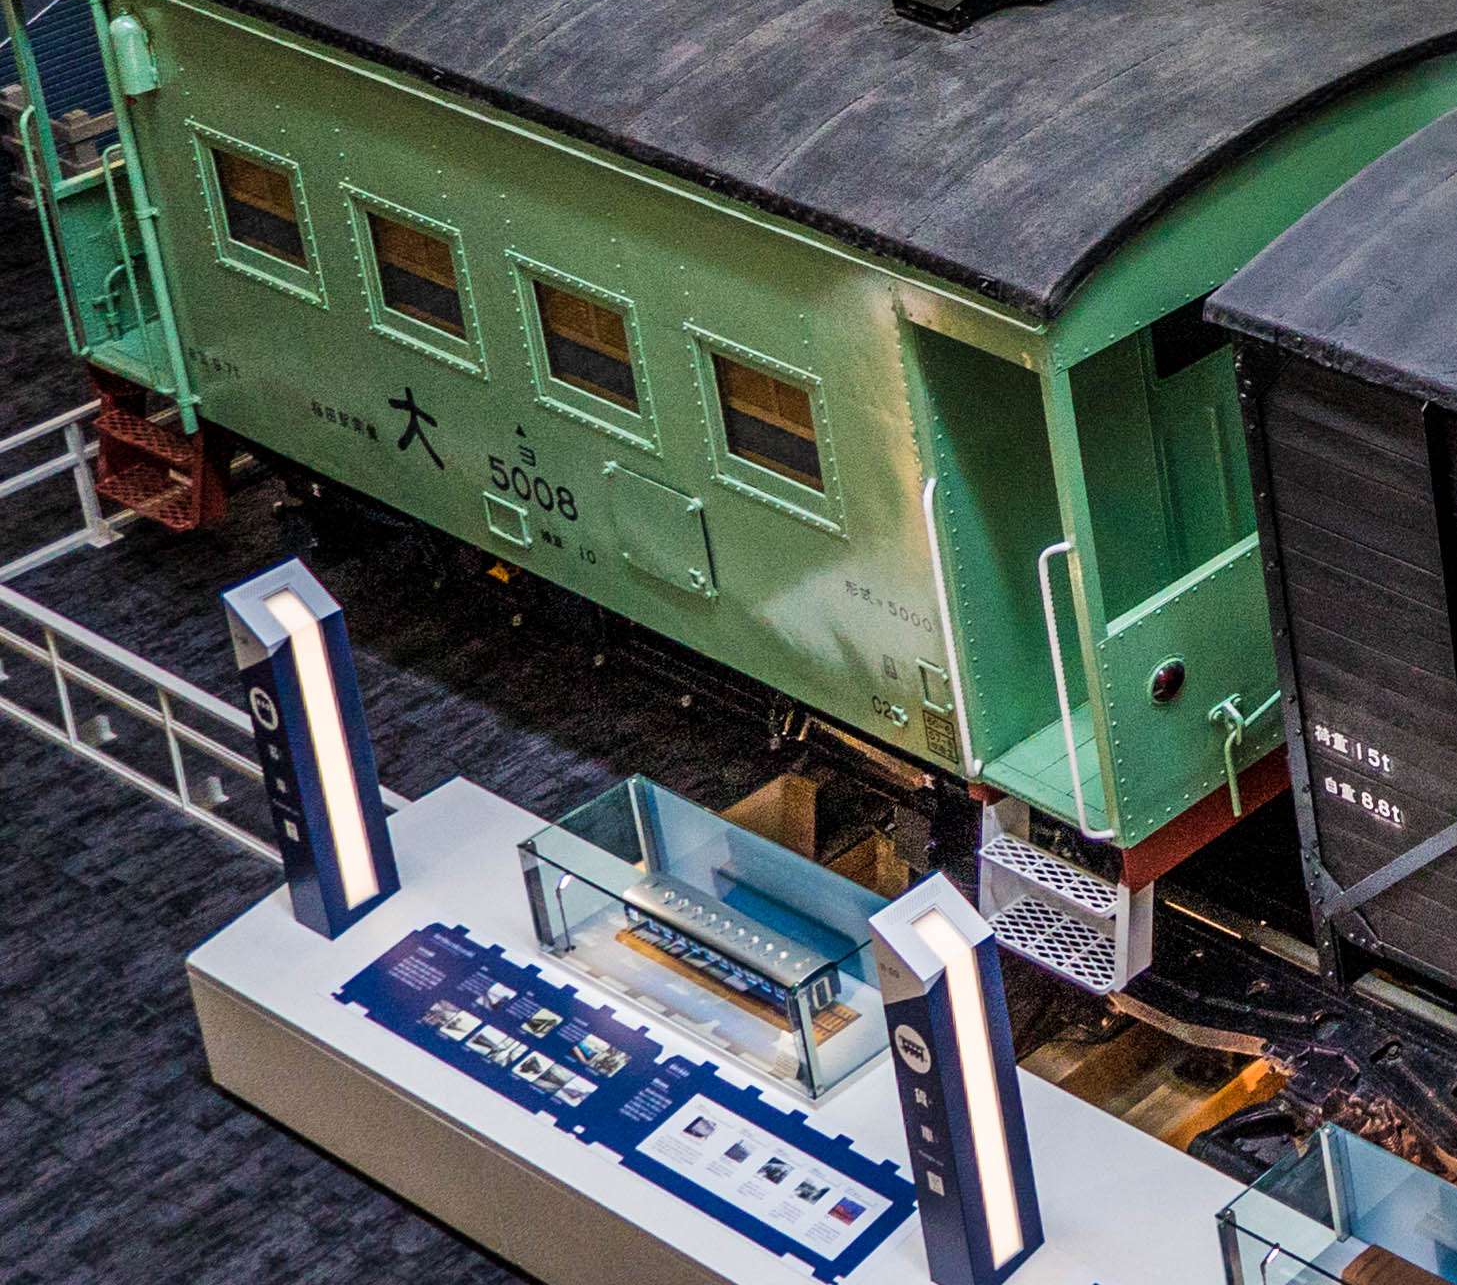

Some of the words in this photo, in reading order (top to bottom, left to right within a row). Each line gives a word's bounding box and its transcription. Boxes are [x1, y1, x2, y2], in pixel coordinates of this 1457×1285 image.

[388, 387, 445, 470] 大
[488, 454, 579, 521] 5008
[1315, 724, 1349, 754] 荷重
[1324, 776, 1357, 804] 自重
[1361, 791, 1401, 823] 8.8t
